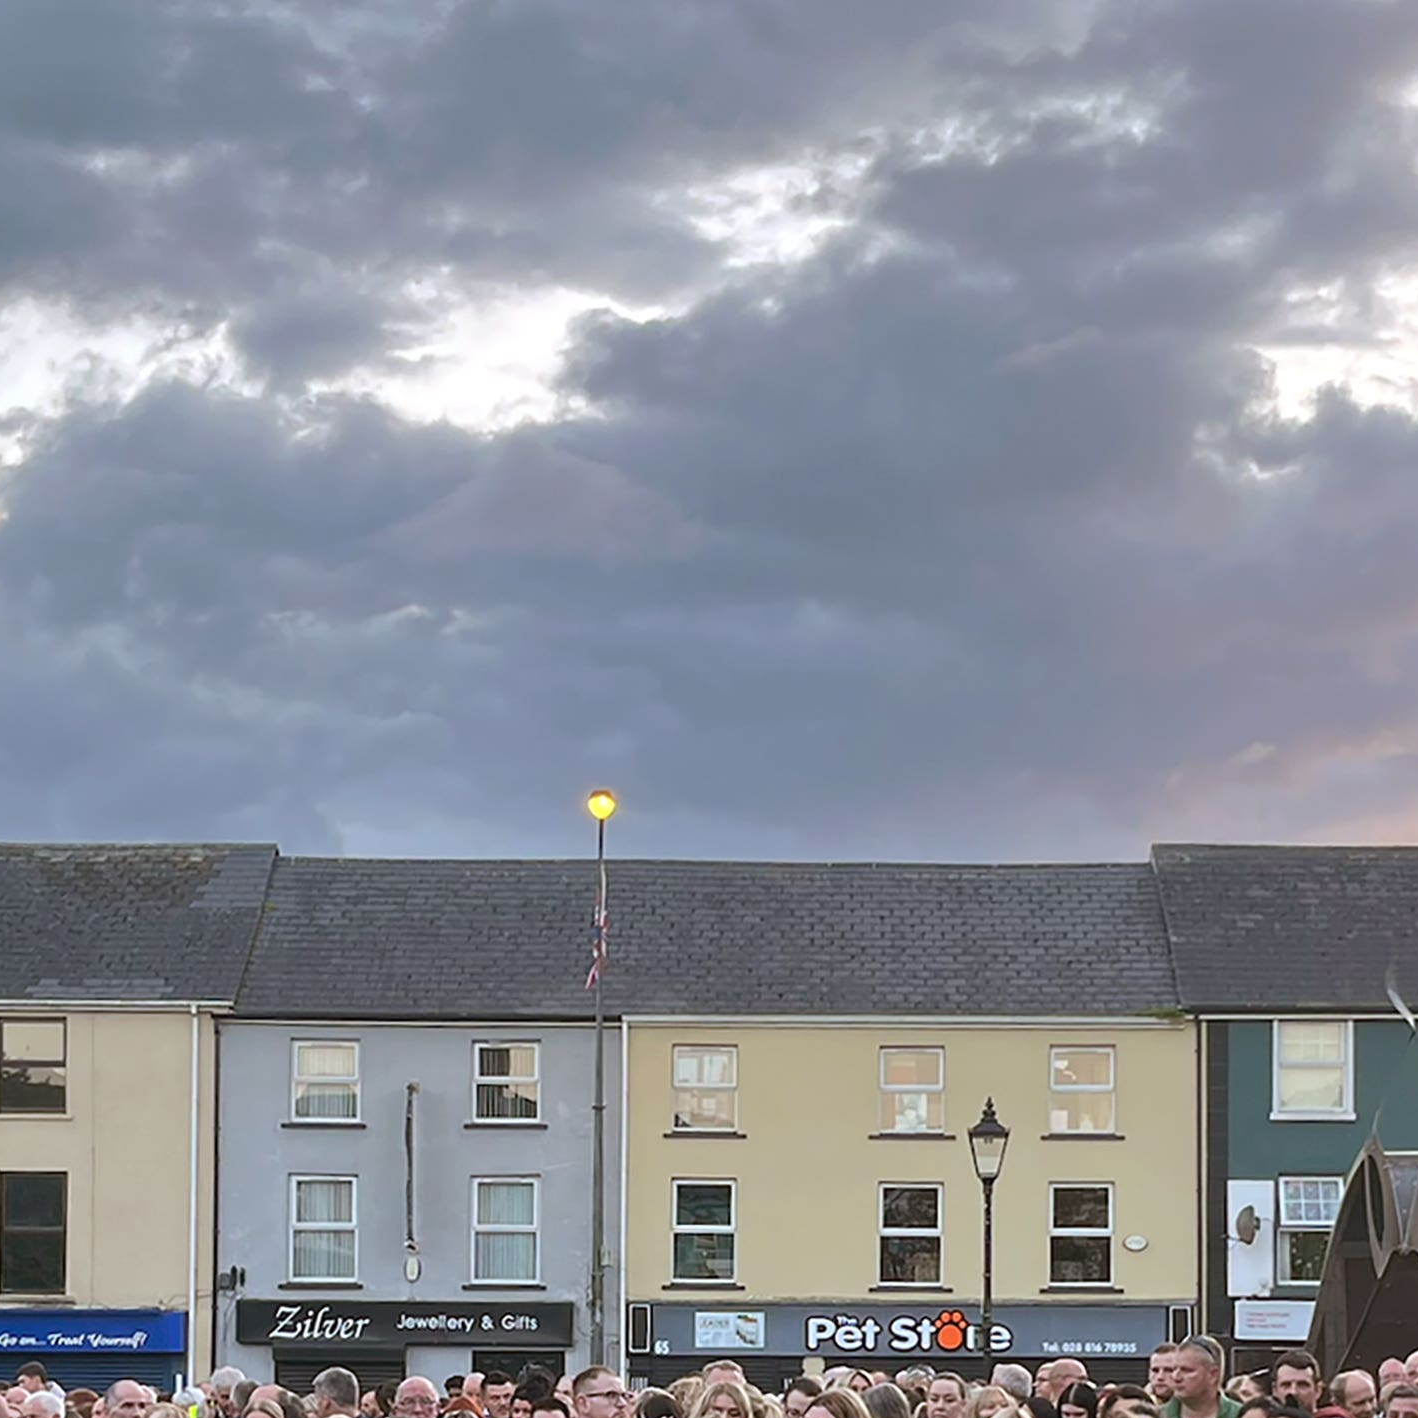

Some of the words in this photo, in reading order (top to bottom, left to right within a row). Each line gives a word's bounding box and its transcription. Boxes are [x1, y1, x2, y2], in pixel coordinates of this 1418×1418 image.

[269, 1305, 370, 1340] Zilver
[397, 1314, 475, 1332] Jewellery
[482, 1315, 494, 1330] &
[501, 1314, 539, 1331] Gifts
[806, 1317, 881, 1351] Pet
[654, 1340, 670, 1355] 65
[1061, 1342, 1083, 1353] 028
